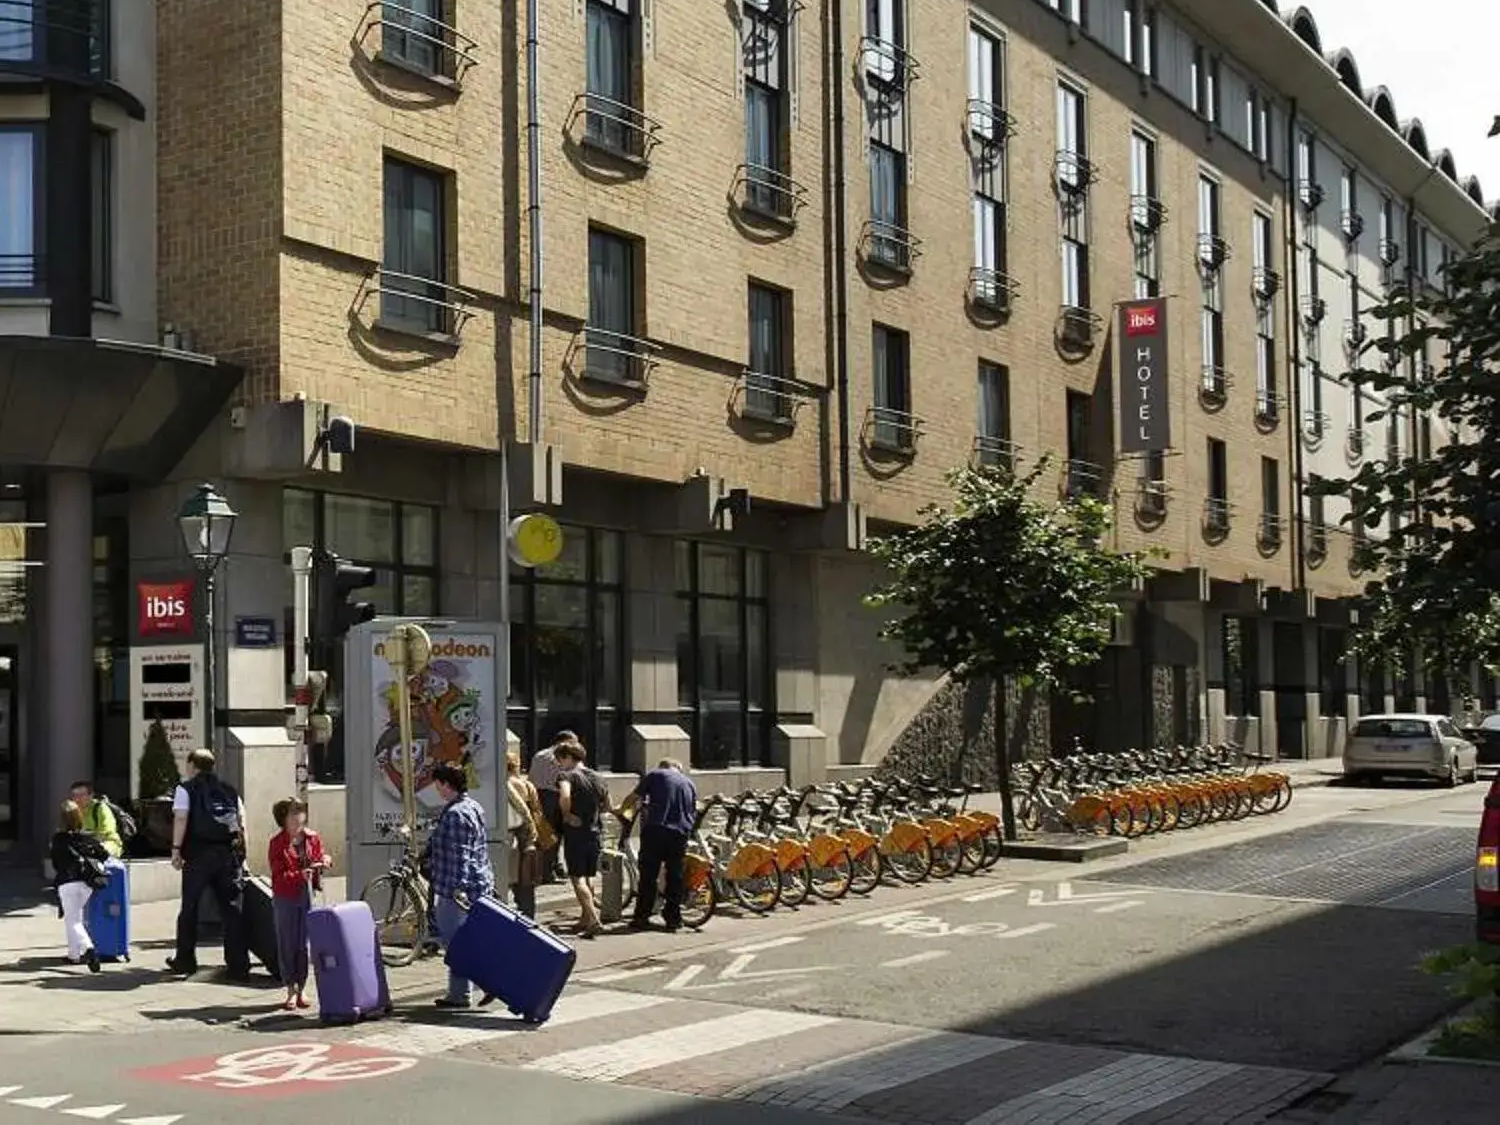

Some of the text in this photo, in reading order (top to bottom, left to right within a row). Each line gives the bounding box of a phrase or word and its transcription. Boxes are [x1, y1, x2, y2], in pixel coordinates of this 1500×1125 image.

[1130, 314, 1155, 328] ibis
[1136, 346, 1151, 440] HOTEL
[147, 595, 185, 618] ibis
[374, 637, 490, 658] nodeon
